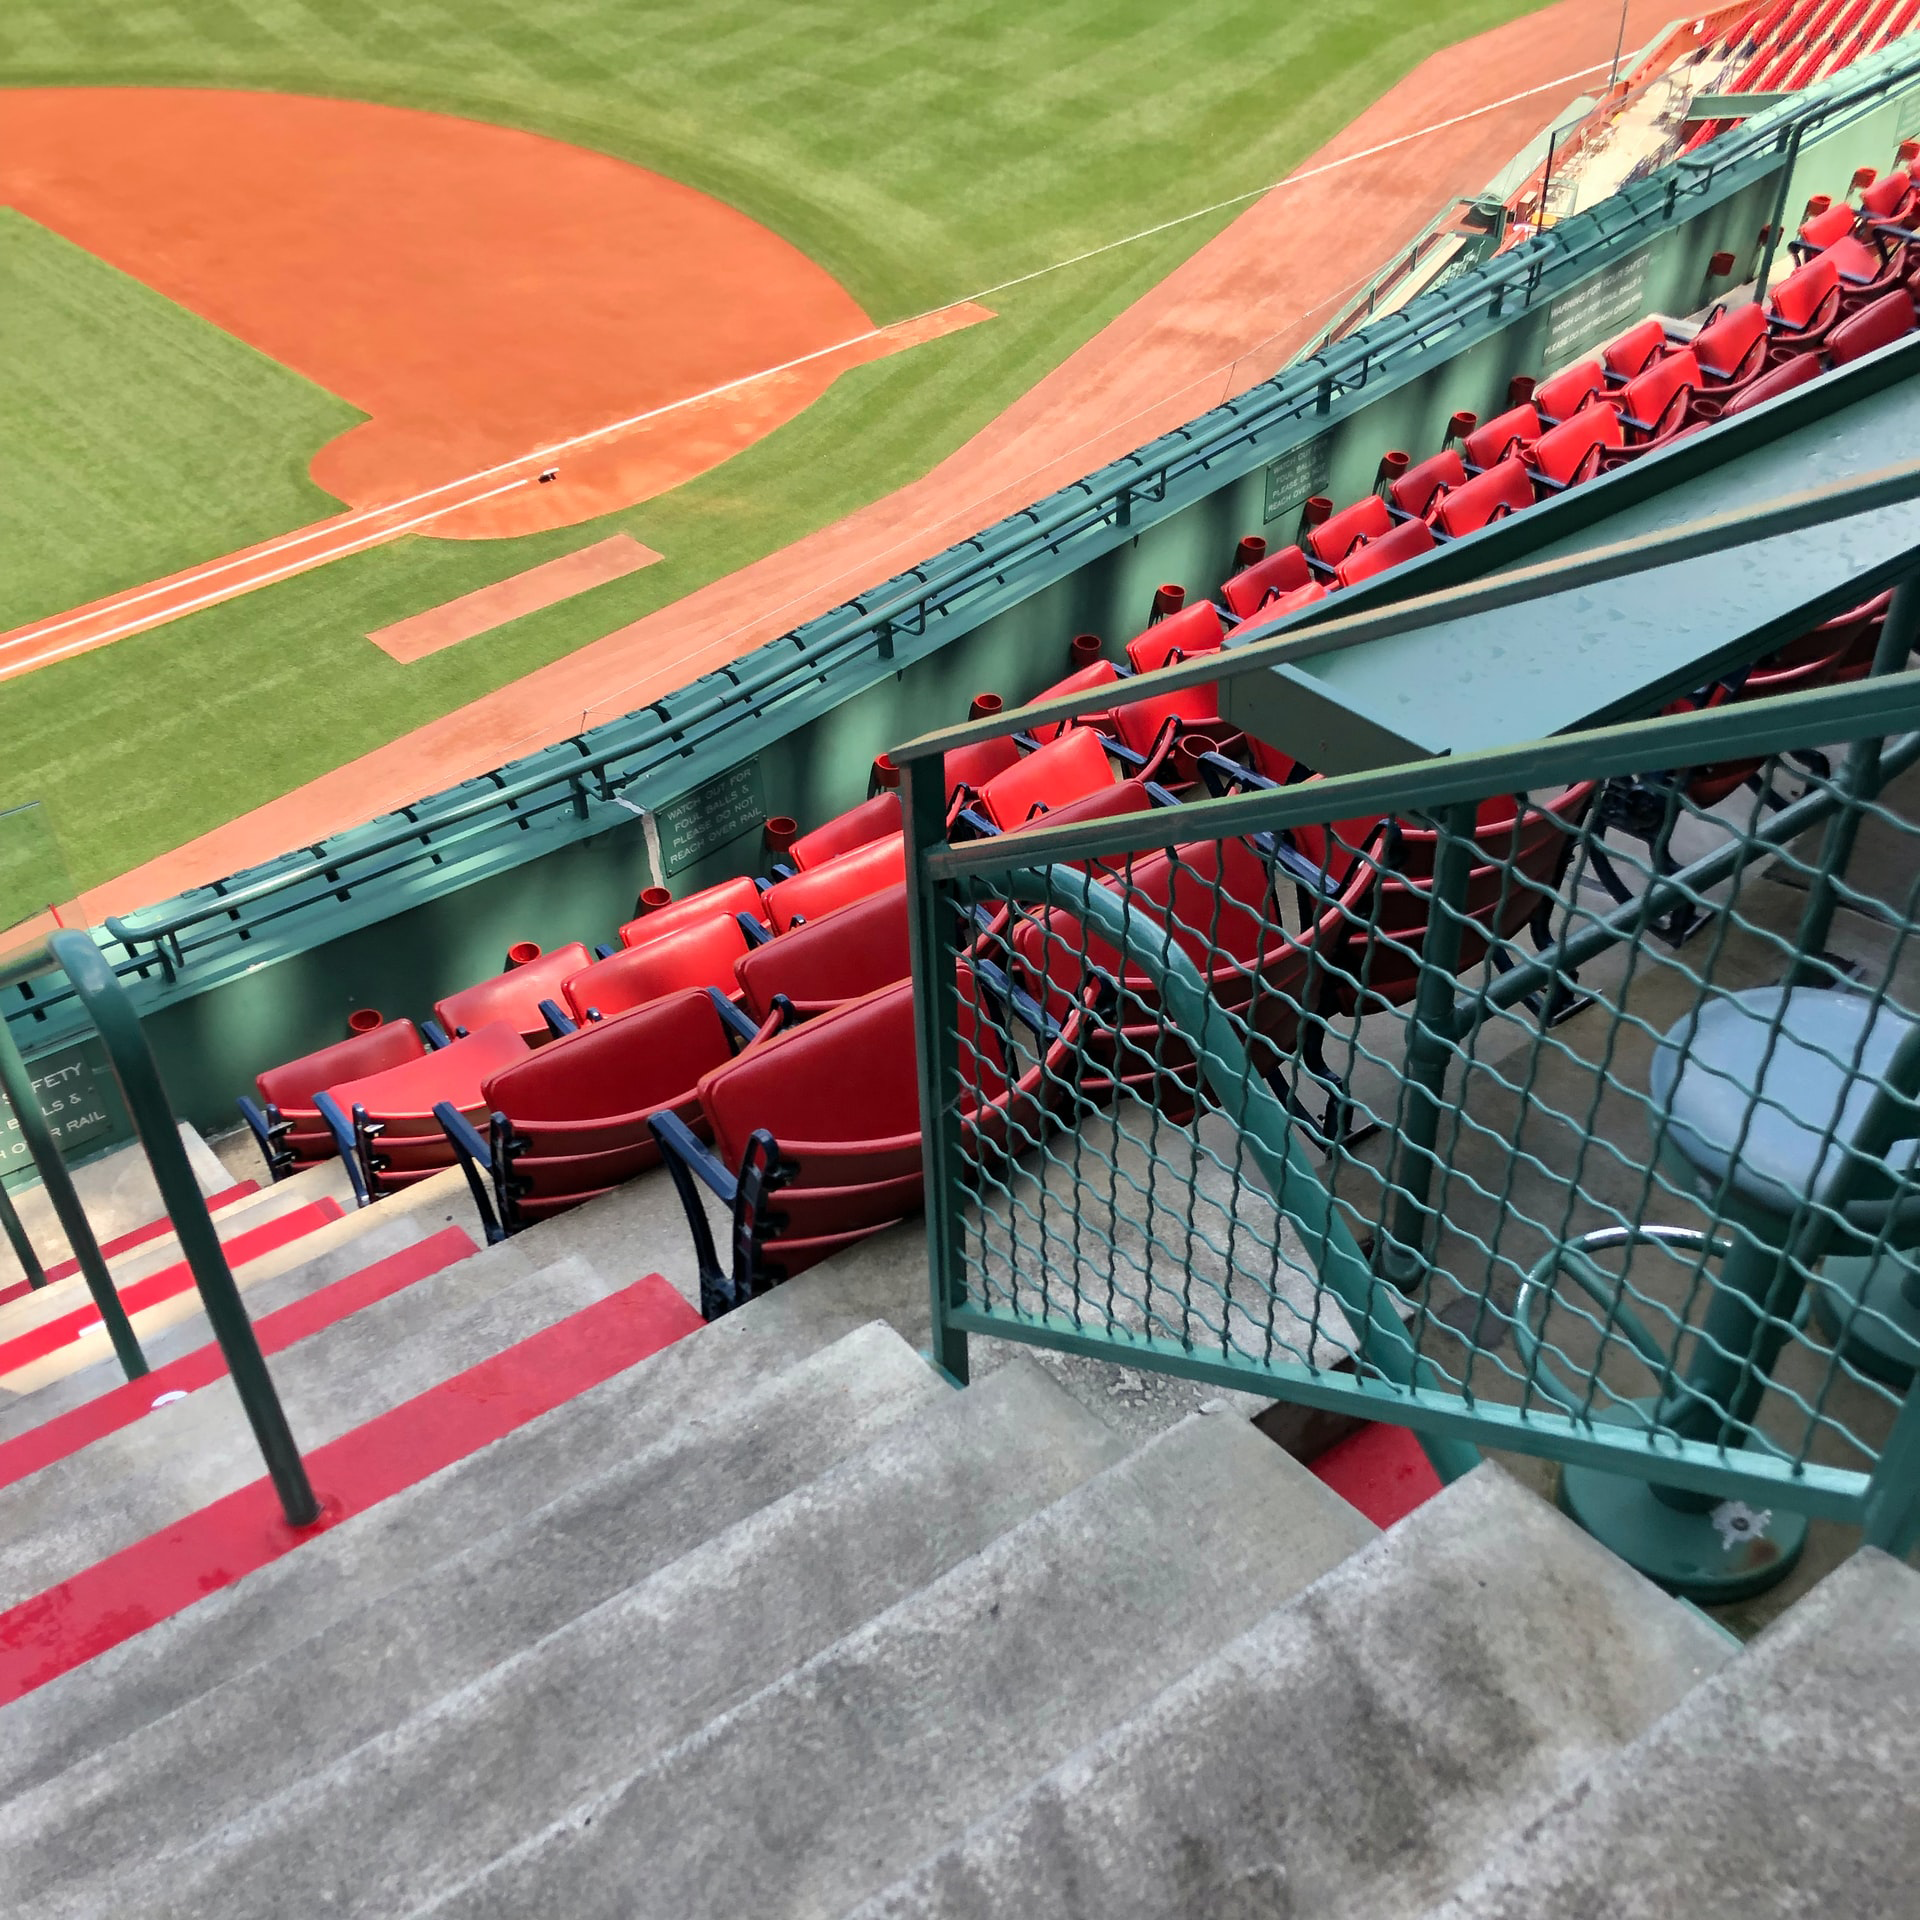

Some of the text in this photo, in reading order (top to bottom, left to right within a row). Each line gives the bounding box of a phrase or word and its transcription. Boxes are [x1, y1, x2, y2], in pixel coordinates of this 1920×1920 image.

[1551, 253, 1650, 319] WARNING FOR YOUR SAFETY
[1552, 316, 1574, 335] WATCH
[1574, 307, 1588, 322] OUT
[1588, 299, 1601, 313] FOR
[1601, 291, 1618, 305] FOUL
[1619, 278, 1638, 295] BALLS
[1544, 337, 1569, 356] PLEASE
[1569, 328, 1580, 342] DO
[1580, 321, 1592, 334] NOT
[1592, 310, 1614, 326] REACH
[1613, 298, 1631, 315] OVER
[1273, 447, 1312, 474] WATCH OUT
[1276, 471, 1294, 484] FOUL
[1296, 457, 1317, 474] BALLS
[1269, 494, 1291, 512] REACH
[1293, 483, 1311, 498] OVER
[1273, 479, 1298, 498] PLEASE
[1300, 472, 1310, 483] DO
[667, 768, 751, 821] WATCH OUT FOR
[674, 784, 749, 832] FOUL BALLS &
[670, 807, 762, 864] REACH OVER RAIL
[673, 795, 755, 848] PLEASE DO NOT
[66, 1111, 107, 1132] RAIL
[69, 1092, 82, 1104] &
